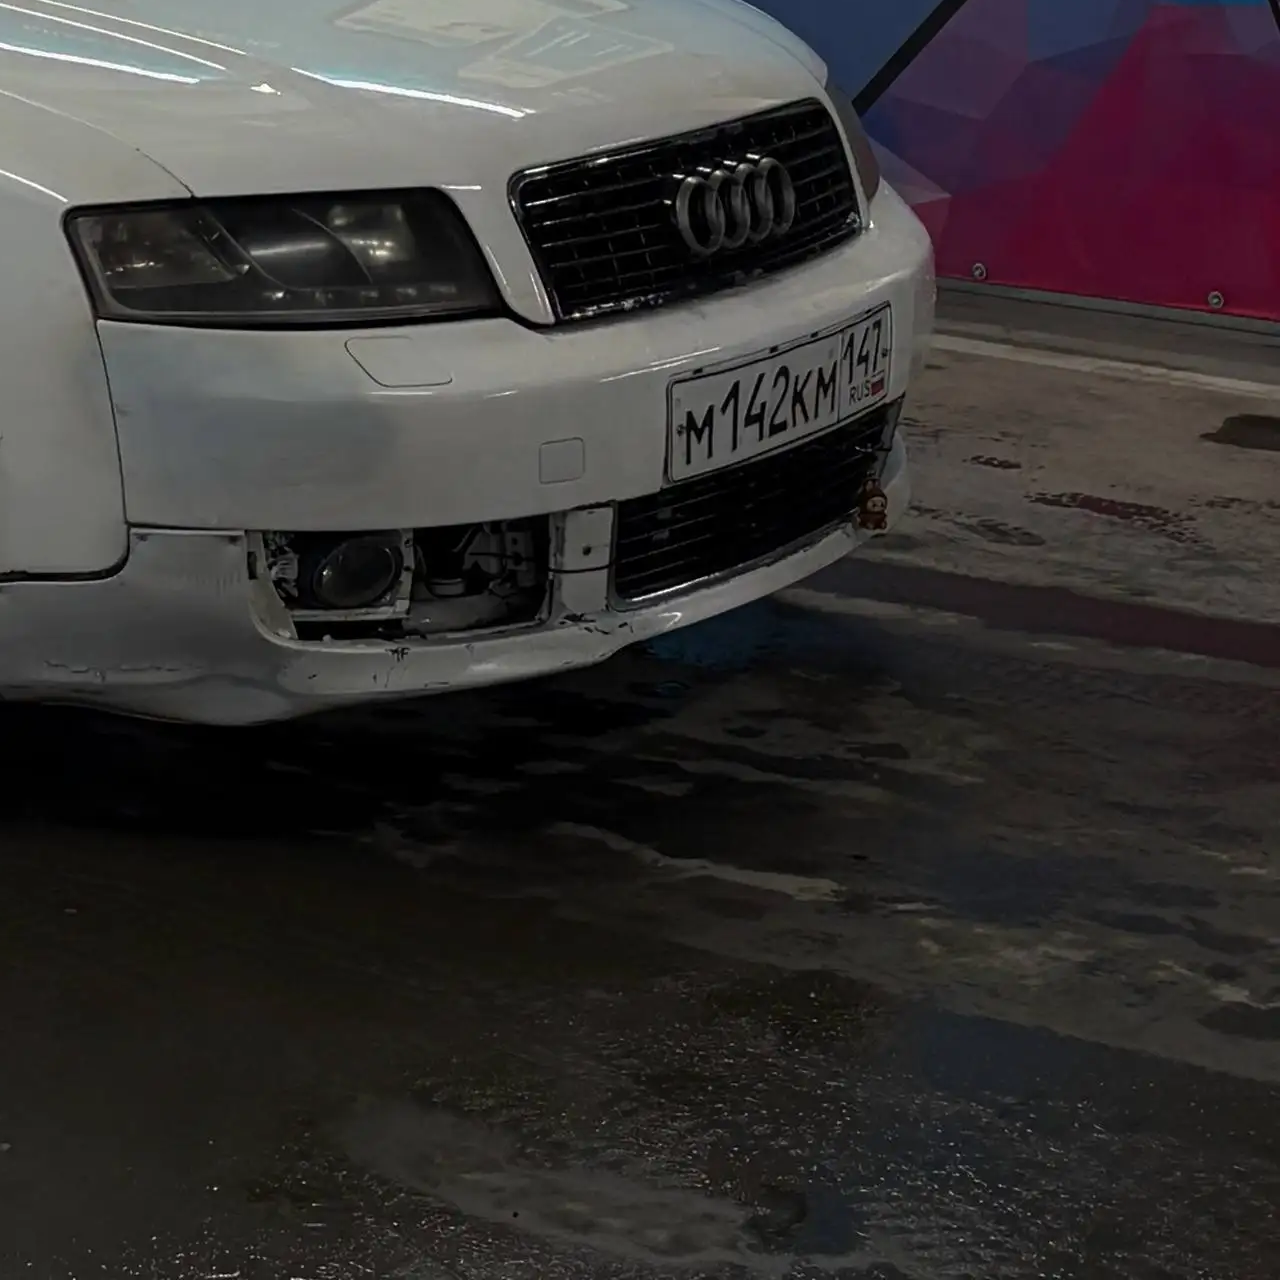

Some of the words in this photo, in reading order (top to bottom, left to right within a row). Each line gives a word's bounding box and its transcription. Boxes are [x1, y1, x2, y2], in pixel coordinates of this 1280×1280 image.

[843, 317, 882, 384] 147
[685, 360, 837, 465] М142КМ
[849, 381, 870, 405] RUS
